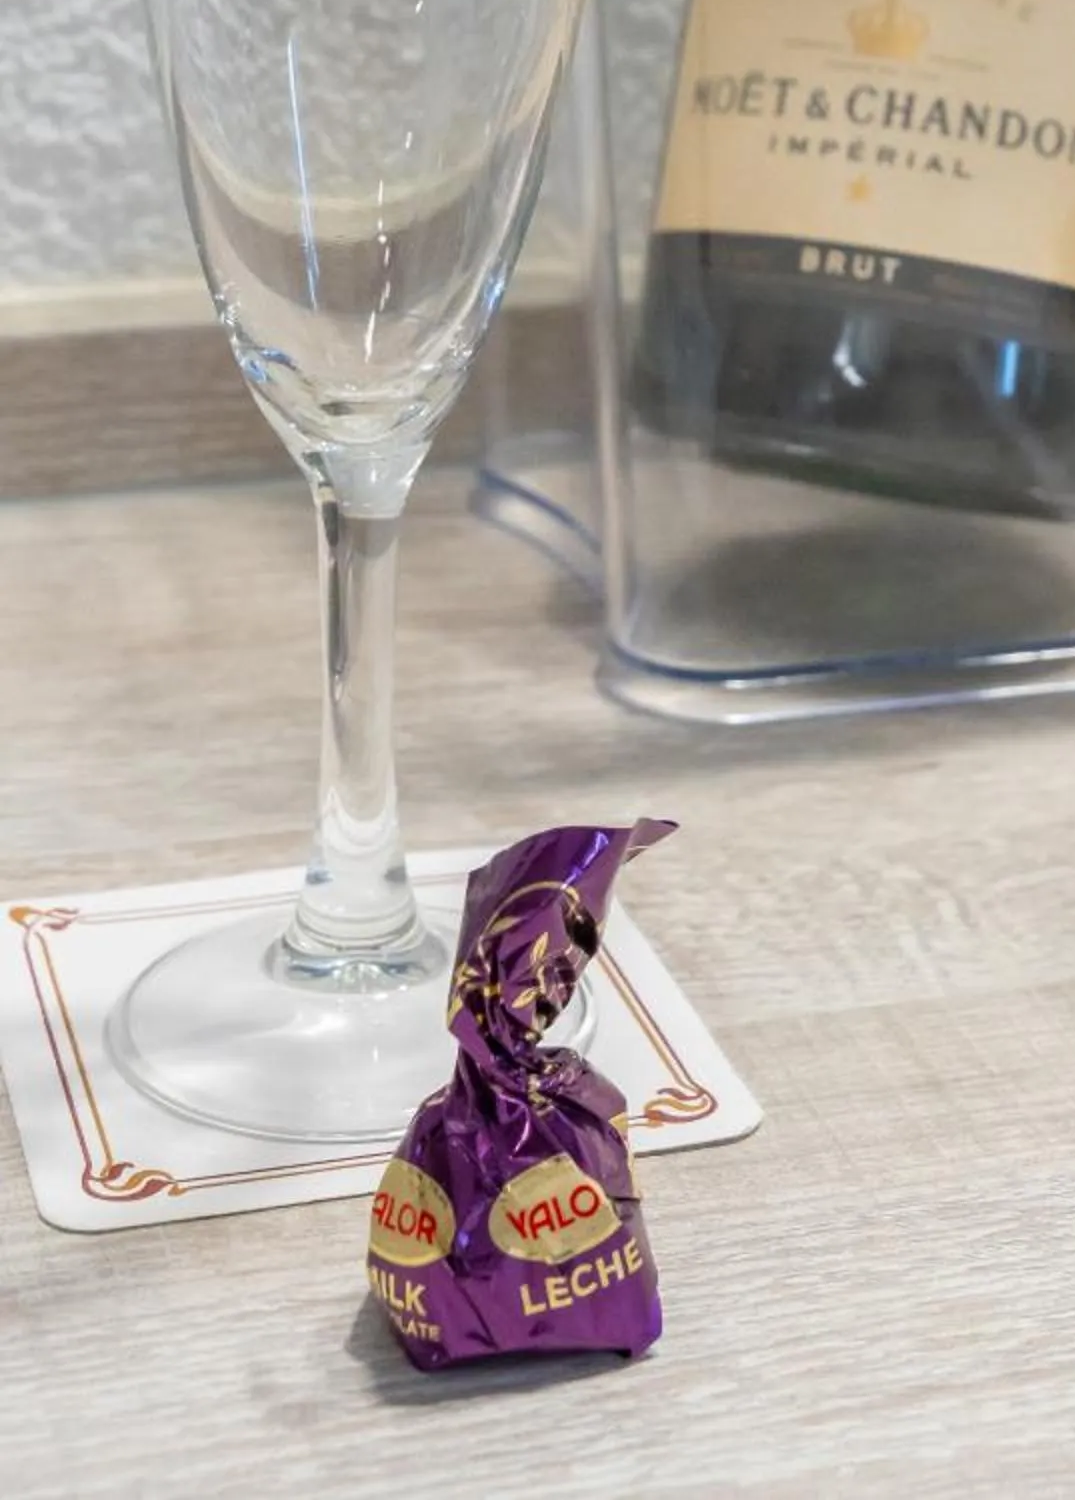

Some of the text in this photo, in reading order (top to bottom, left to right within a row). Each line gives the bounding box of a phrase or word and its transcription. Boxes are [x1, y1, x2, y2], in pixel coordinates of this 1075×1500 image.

[804, 86, 829, 121] &
[799, 245, 901, 284] BRUT
[372, 1191, 437, 1245] ALOR
[506, 1183, 600, 1241] VALO
[520, 1237, 643, 1316] LECHE
